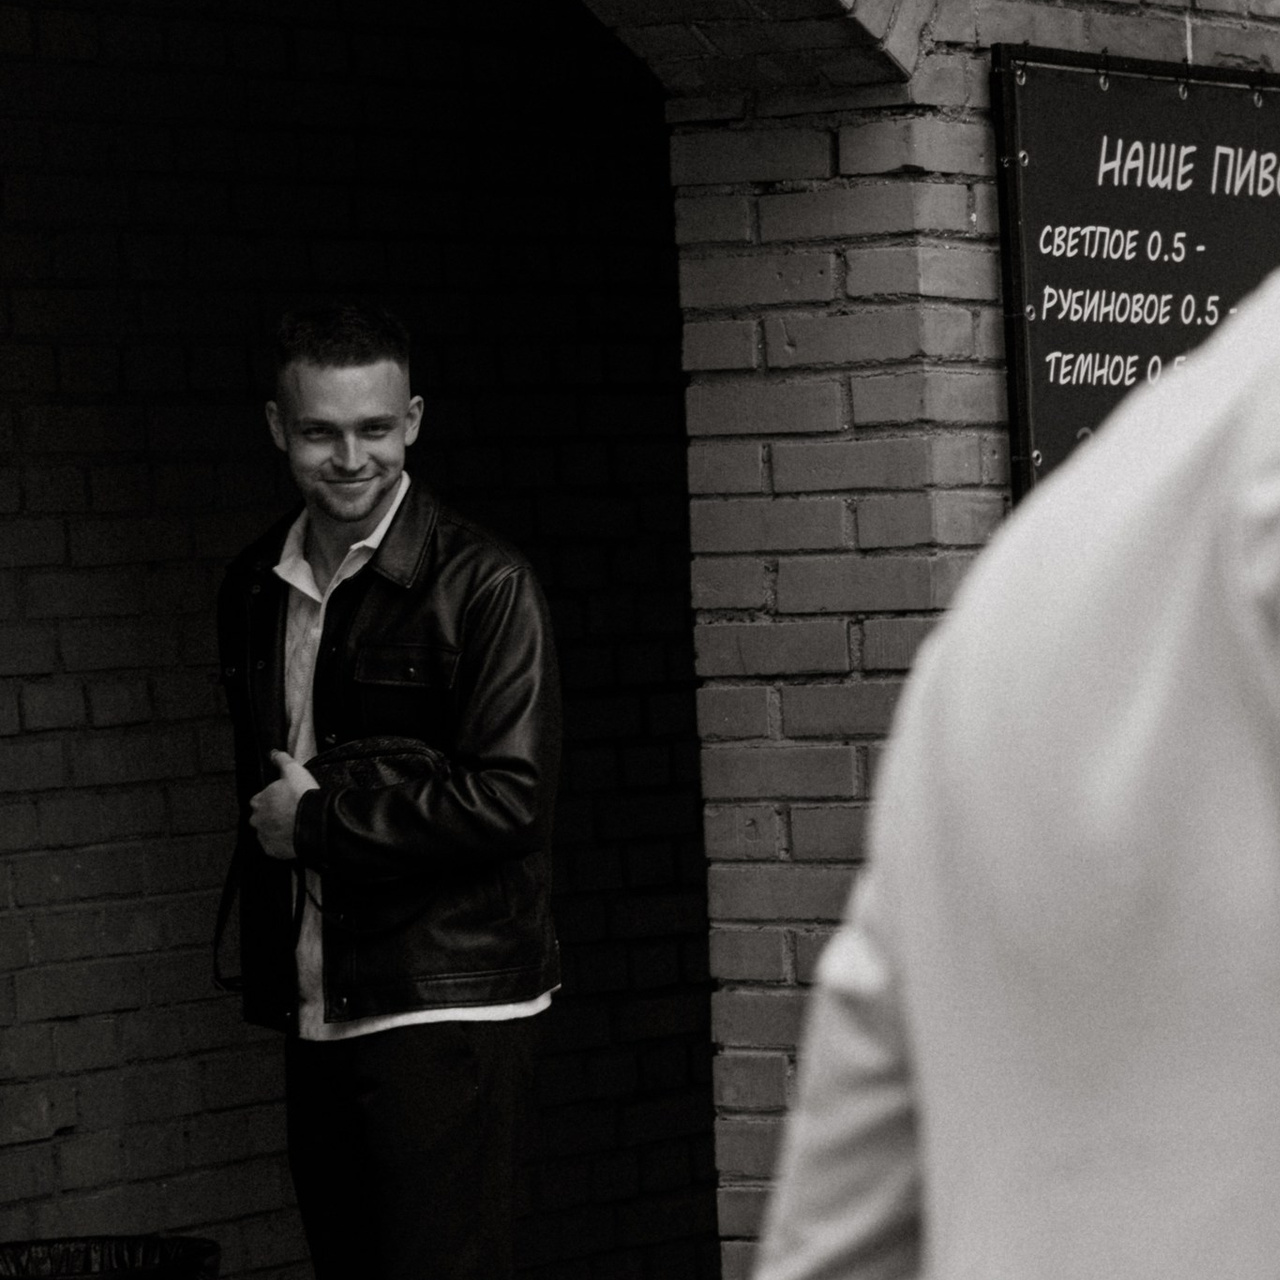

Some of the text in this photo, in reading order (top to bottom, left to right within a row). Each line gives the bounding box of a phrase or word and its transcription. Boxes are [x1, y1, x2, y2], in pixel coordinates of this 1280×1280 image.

[1097, 134, 1198, 192] НАШЕ
[1038, 224, 1140, 261] СВЕТЛОЕ
[1146, 230, 1187, 263] 0.5
[1041, 284, 1174, 325] РУБИНОВОЕ
[1180, 293, 1220, 326] 0.5
[1044, 350, 1140, 387] ТЕМНОЕ
